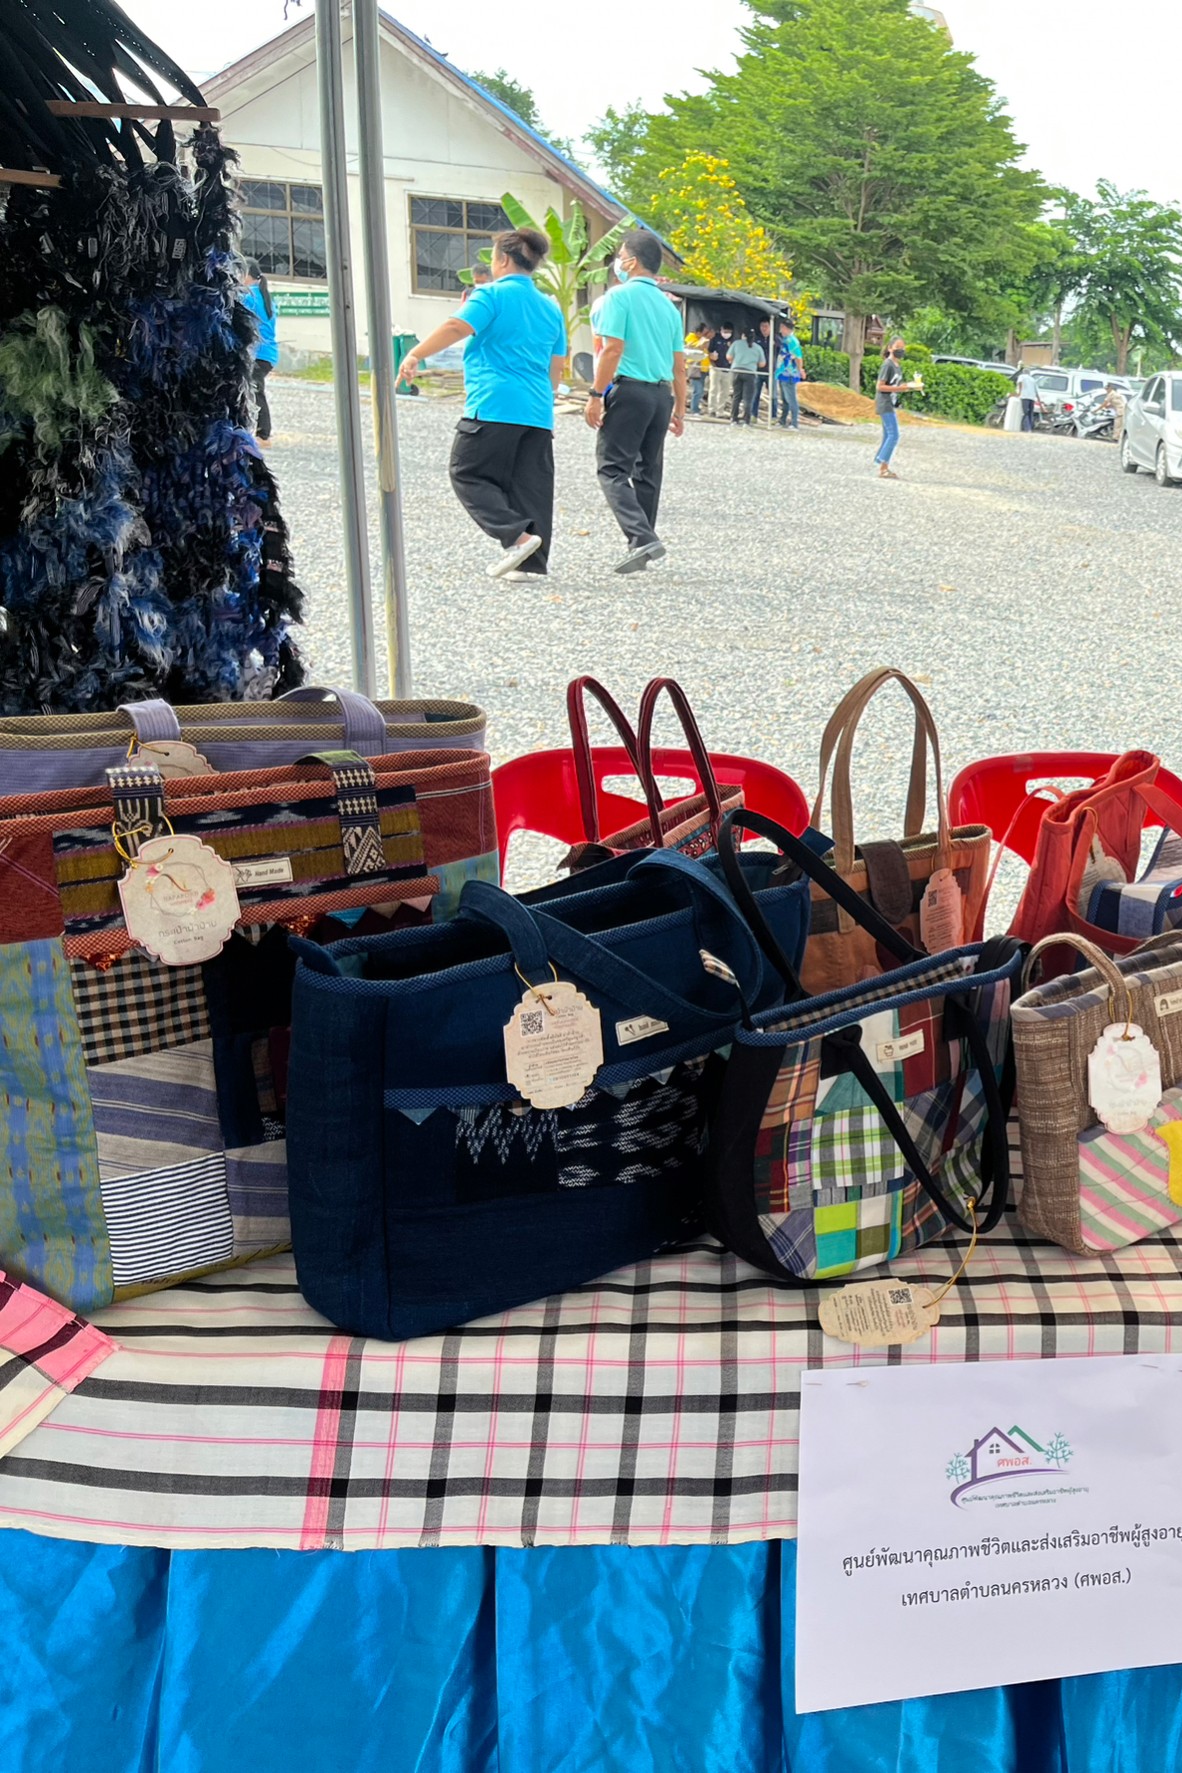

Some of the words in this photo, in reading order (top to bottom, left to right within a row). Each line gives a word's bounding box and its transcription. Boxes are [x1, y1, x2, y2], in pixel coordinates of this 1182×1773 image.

[901, 1574, 1070, 1607] เทศบาลตำบลนครหลวง
[1074, 1567, 1133, 1590] (ศพอส.)
